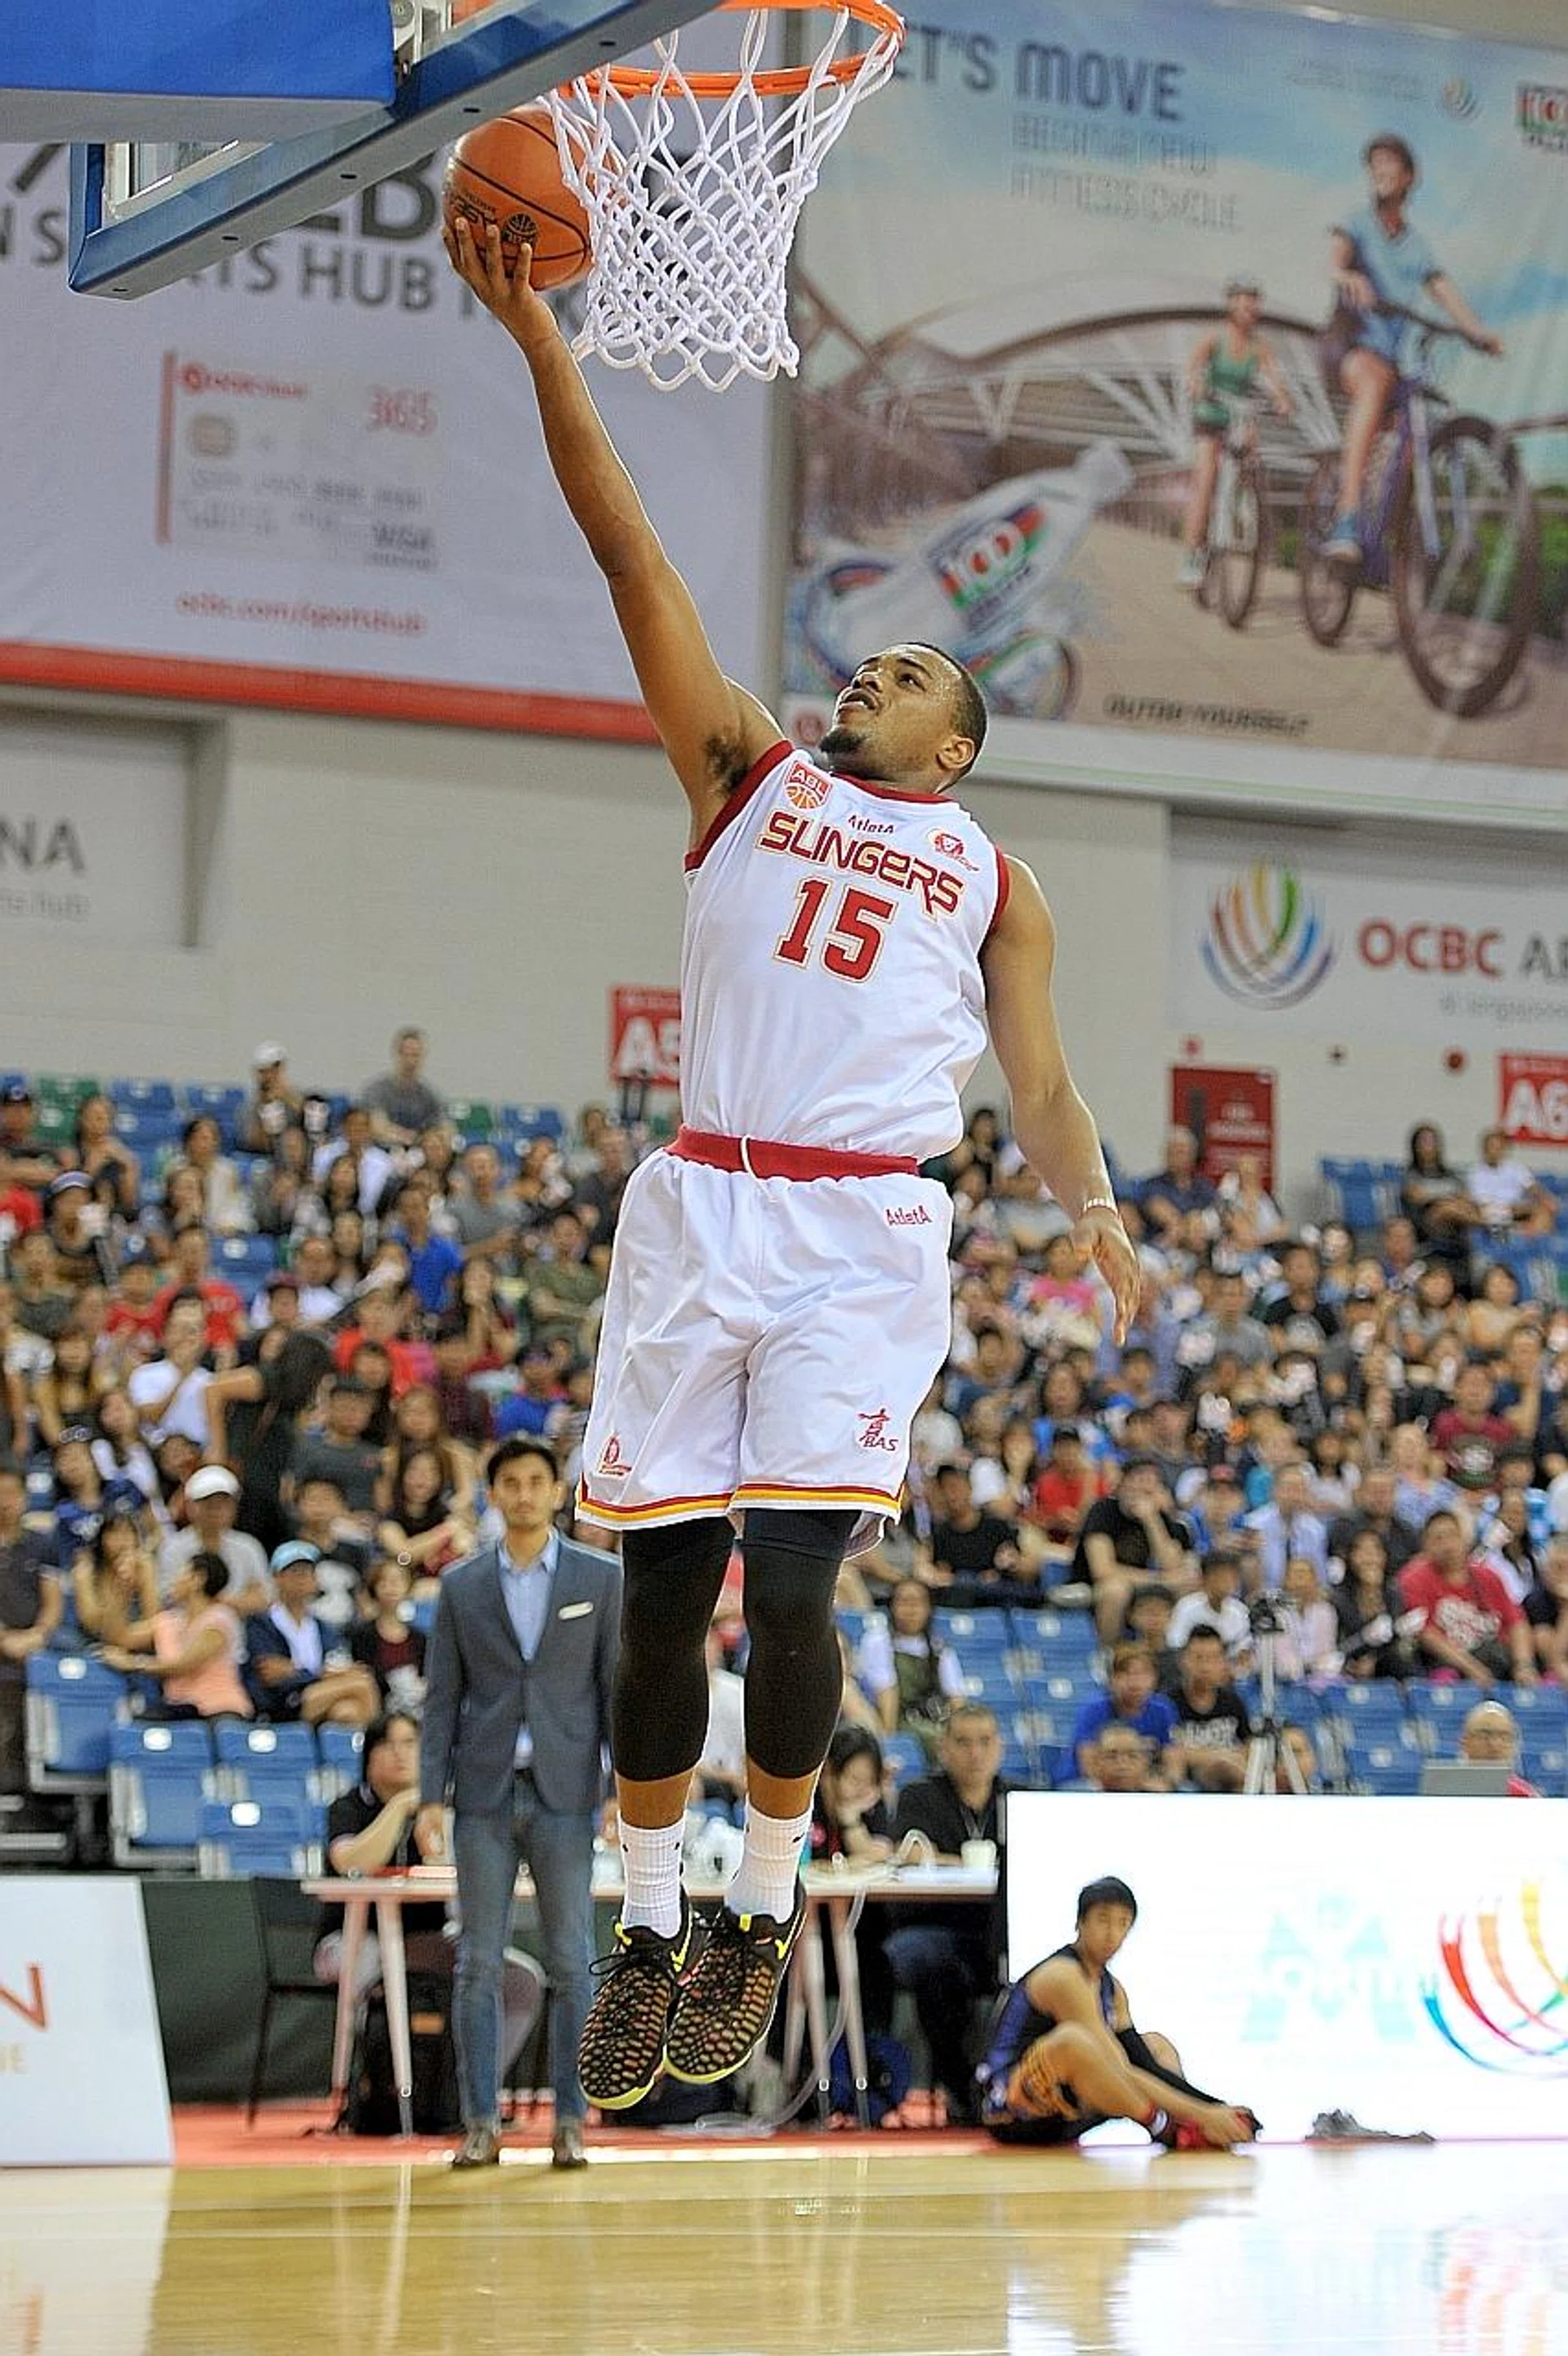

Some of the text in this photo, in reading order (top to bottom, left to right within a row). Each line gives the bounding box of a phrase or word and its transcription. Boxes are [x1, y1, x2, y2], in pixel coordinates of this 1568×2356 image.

[301, 242, 437, 314] HUB
[791, 766, 827, 795] ABL
[759, 809, 967, 919] SLINGERS
[773, 876, 898, 983] 15
[1357, 917, 1505, 978] OCBC
